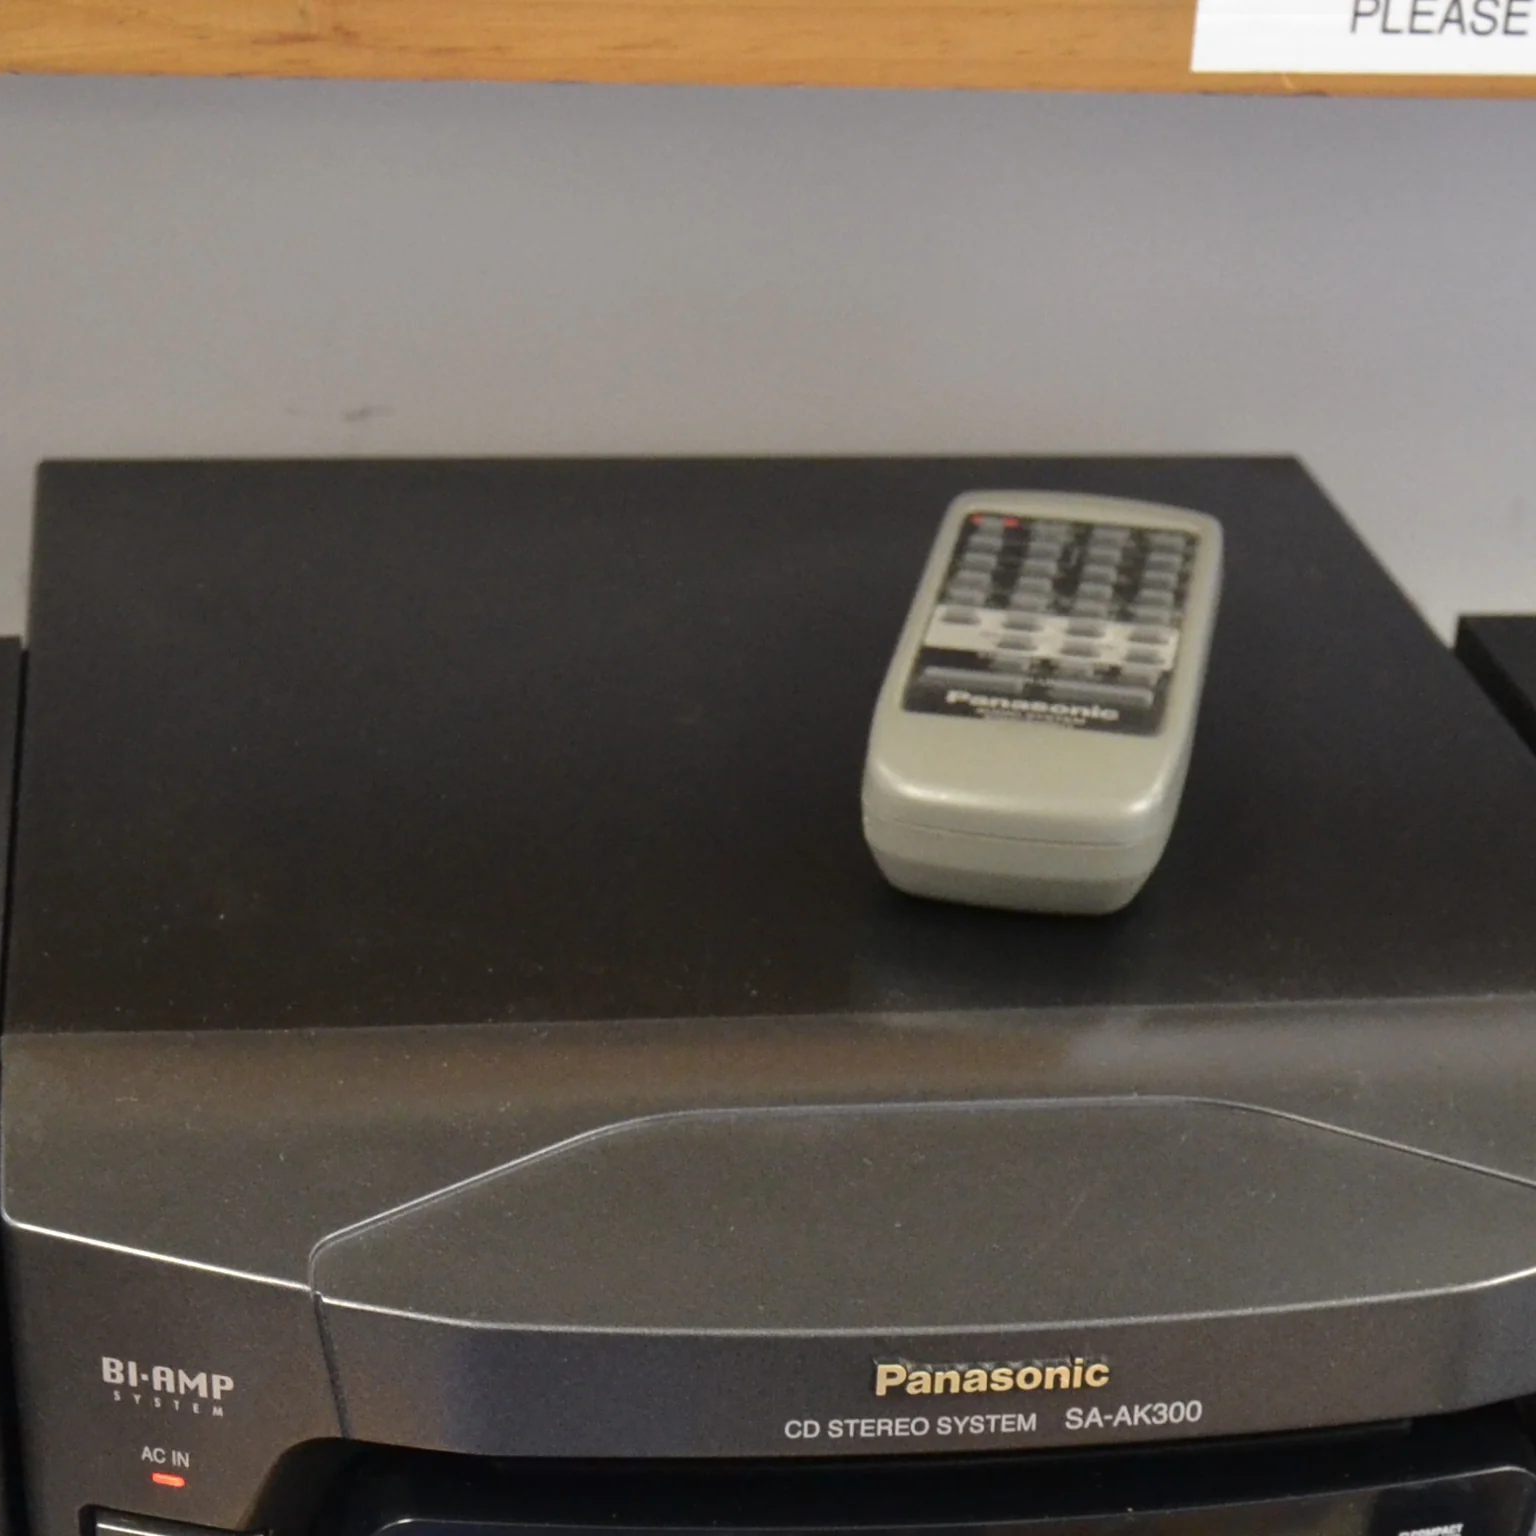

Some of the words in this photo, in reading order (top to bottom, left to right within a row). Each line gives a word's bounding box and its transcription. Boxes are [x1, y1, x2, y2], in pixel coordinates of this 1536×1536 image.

[1349, 0, 1533, 36] PLEASE
[946, 689, 1120, 721] Panasonic
[101, 1356, 235, 1400] BI-AMP
[875, 1358, 1111, 1397] Panasonic
[113, 1390, 224, 1416] SYSTEM
[784, 1419, 820, 1439] CD
[827, 1416, 930, 1438] STEREO
[936, 1412, 1037, 1435] SYSTEM
[1065, 1400, 1203, 1430] SA-AK300
[141, 1446, 167, 1464] AC
[172, 1450, 190, 1467] IN
